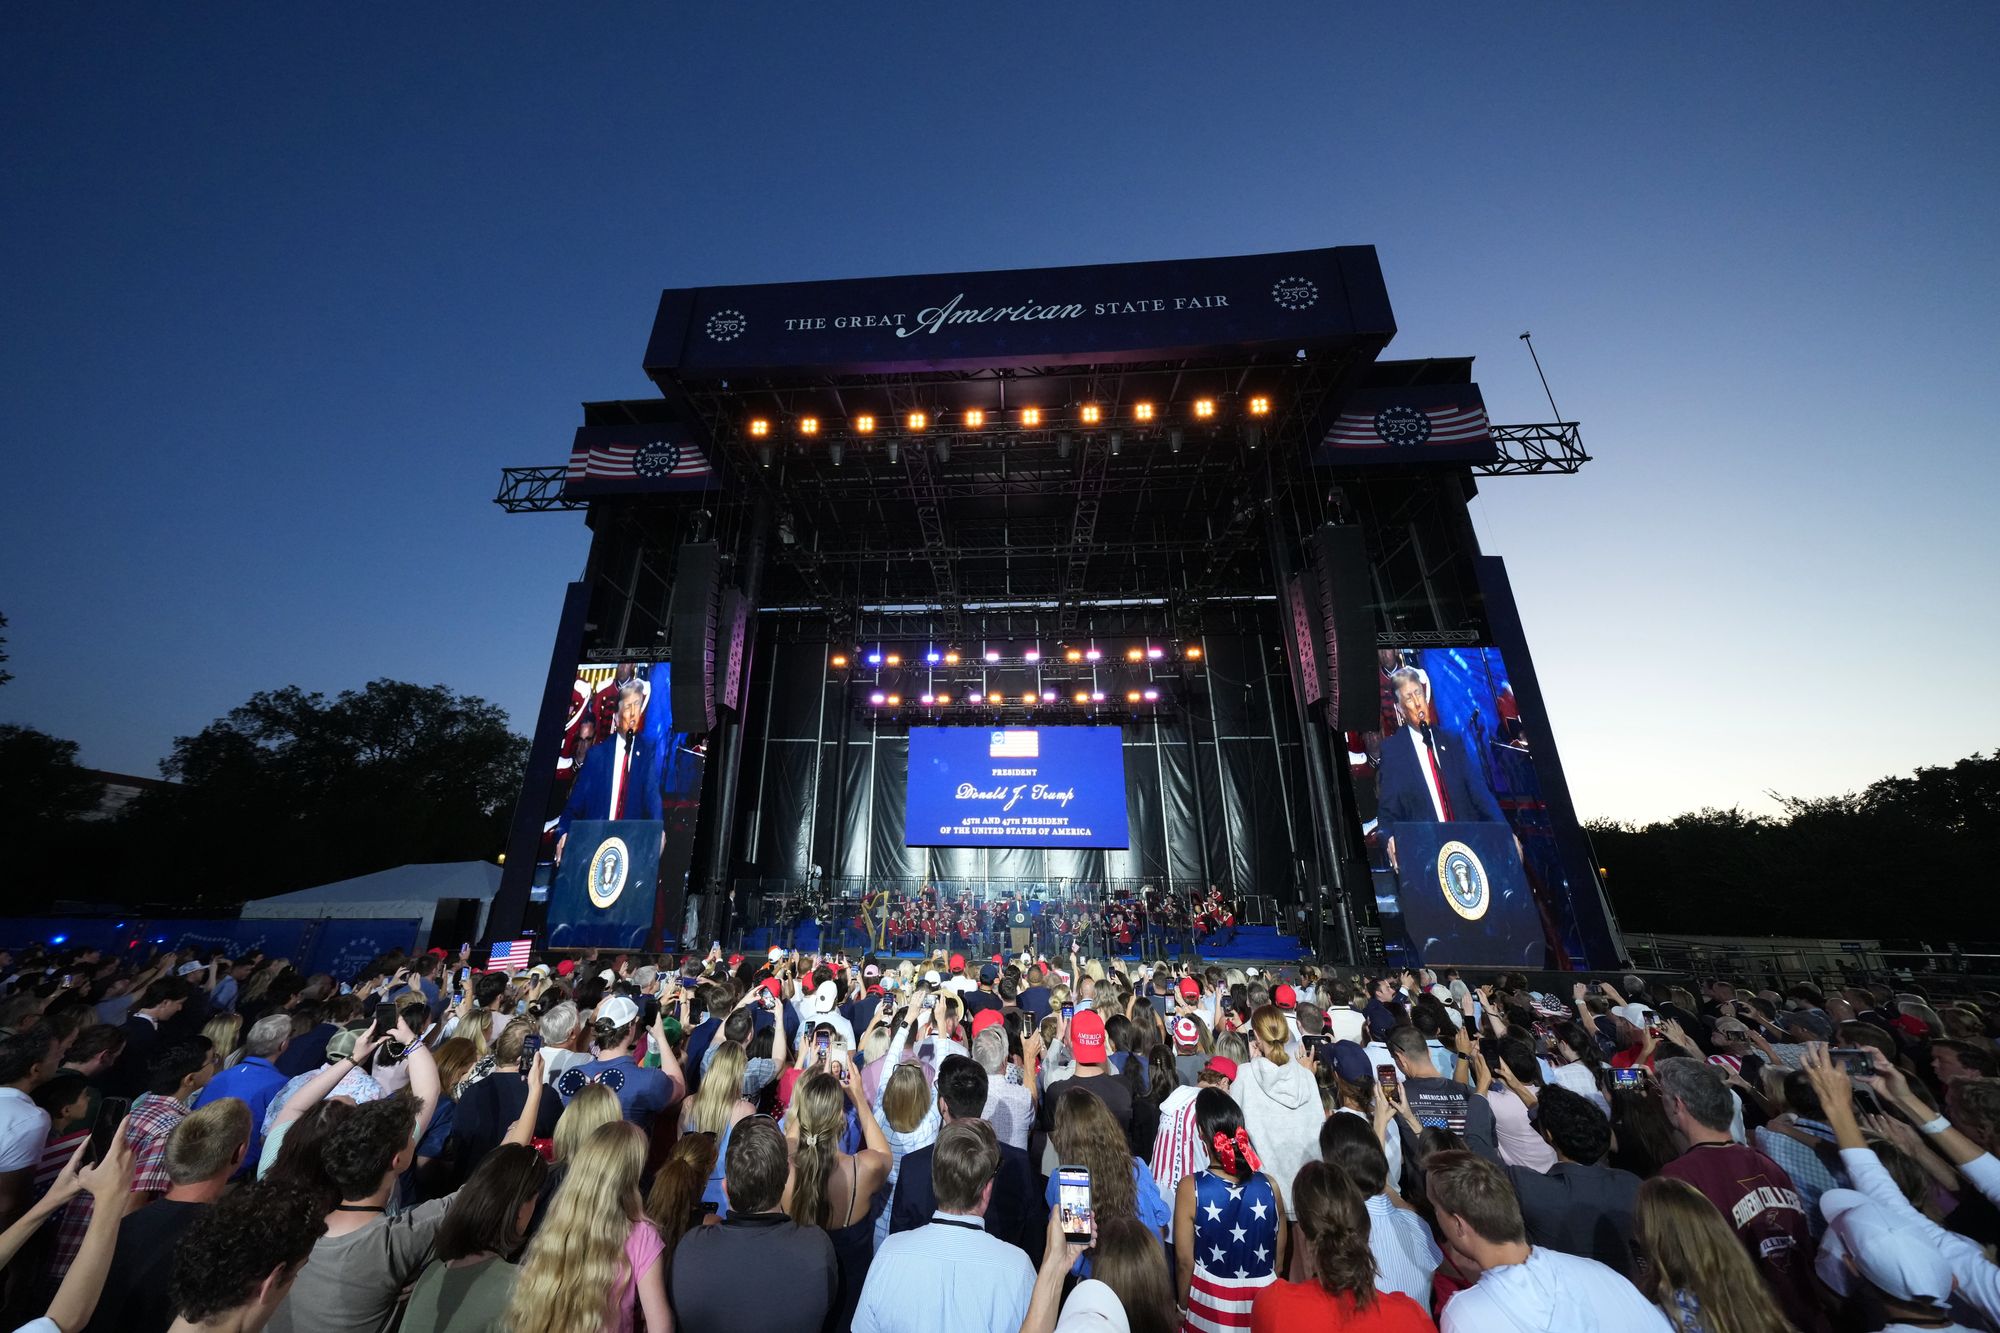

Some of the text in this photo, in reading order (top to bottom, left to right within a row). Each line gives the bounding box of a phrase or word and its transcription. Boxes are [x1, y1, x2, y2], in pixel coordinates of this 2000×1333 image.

[1283, 290, 1310, 302] 250
[785, 293, 1230, 338] THE GREAT American STATE FAIR
[714, 323, 738, 334] 250
[1389, 422, 1418, 436] 250
[644, 457, 669, 468] 250
[955, 782, 1075, 812] Donald J. Trump
[982, 817, 1001, 825] AND
[1021, 817, 1069, 825] PRESIDENT
[940, 826, 1092, 836] OF THE UNITED STATES OF AMERICA
[1419, 1093, 1465, 1101] AMERICAN FLAG
